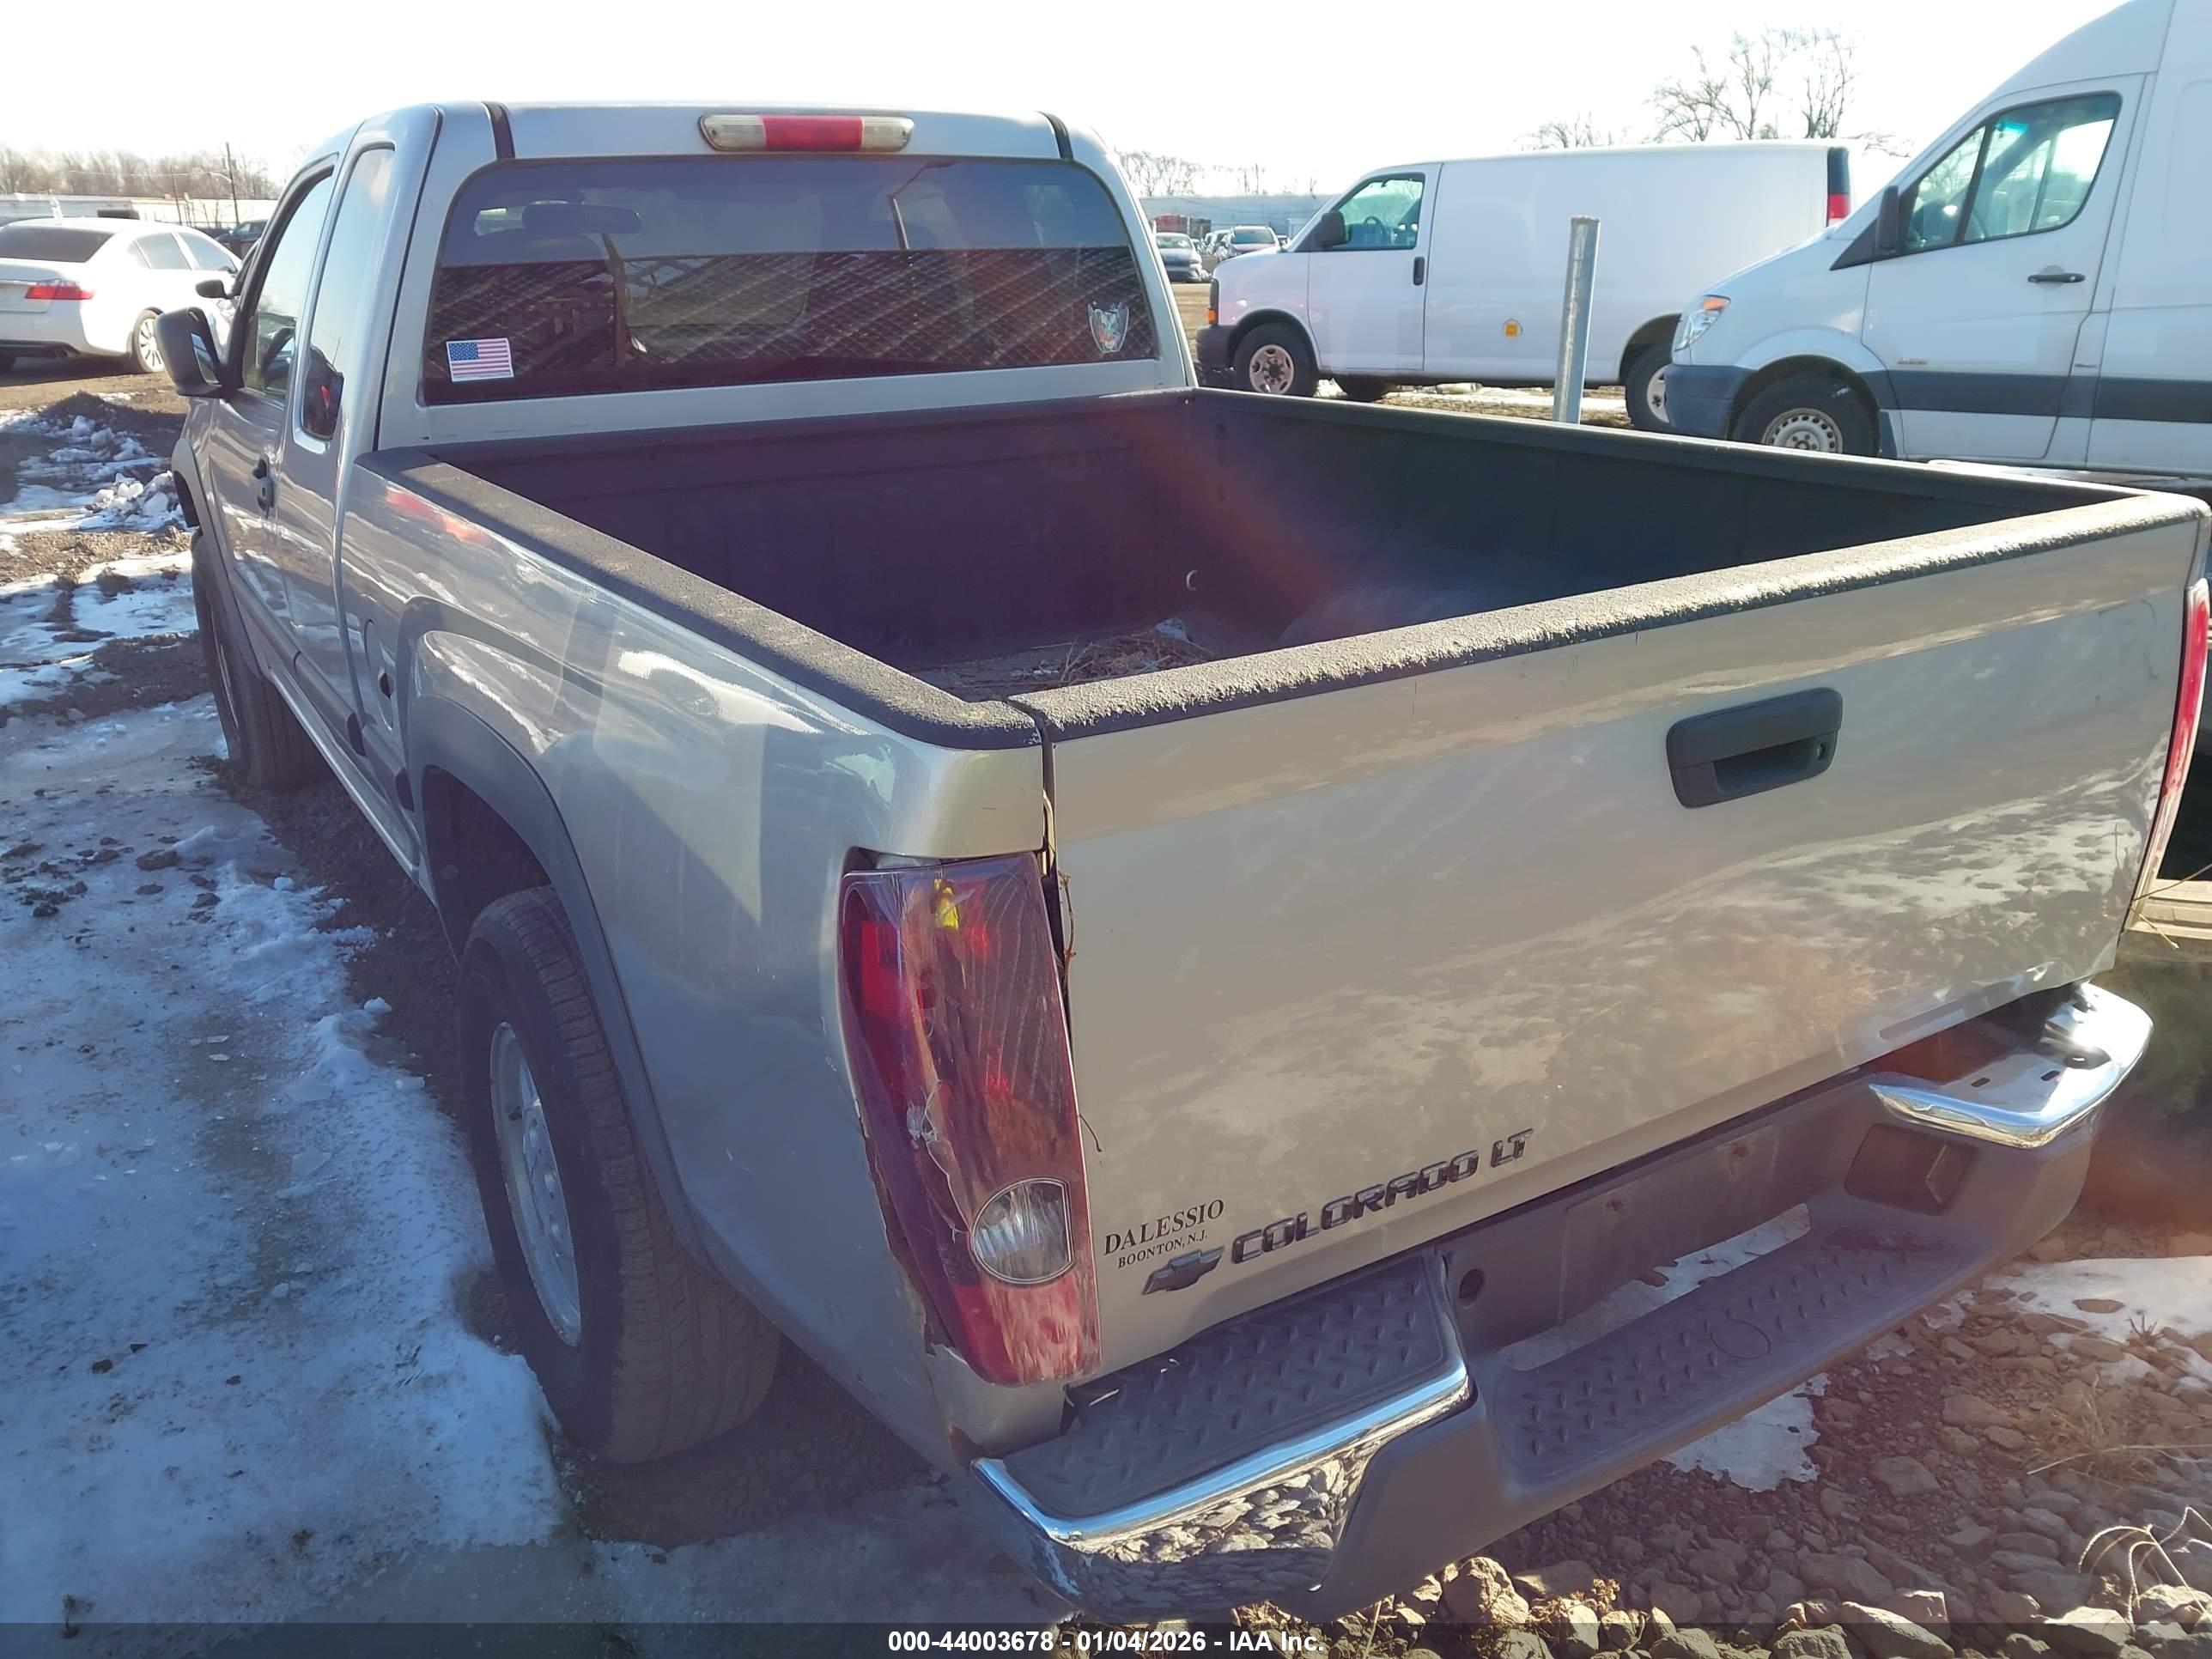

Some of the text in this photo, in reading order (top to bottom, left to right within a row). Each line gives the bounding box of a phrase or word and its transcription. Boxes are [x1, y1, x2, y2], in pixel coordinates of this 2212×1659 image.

[1231, 1127, 1534, 1264] COLORADO LT
[1103, 1199, 1224, 1255] DALESSIO
[1118, 1229, 1208, 1268] BOONTON, N.J.
